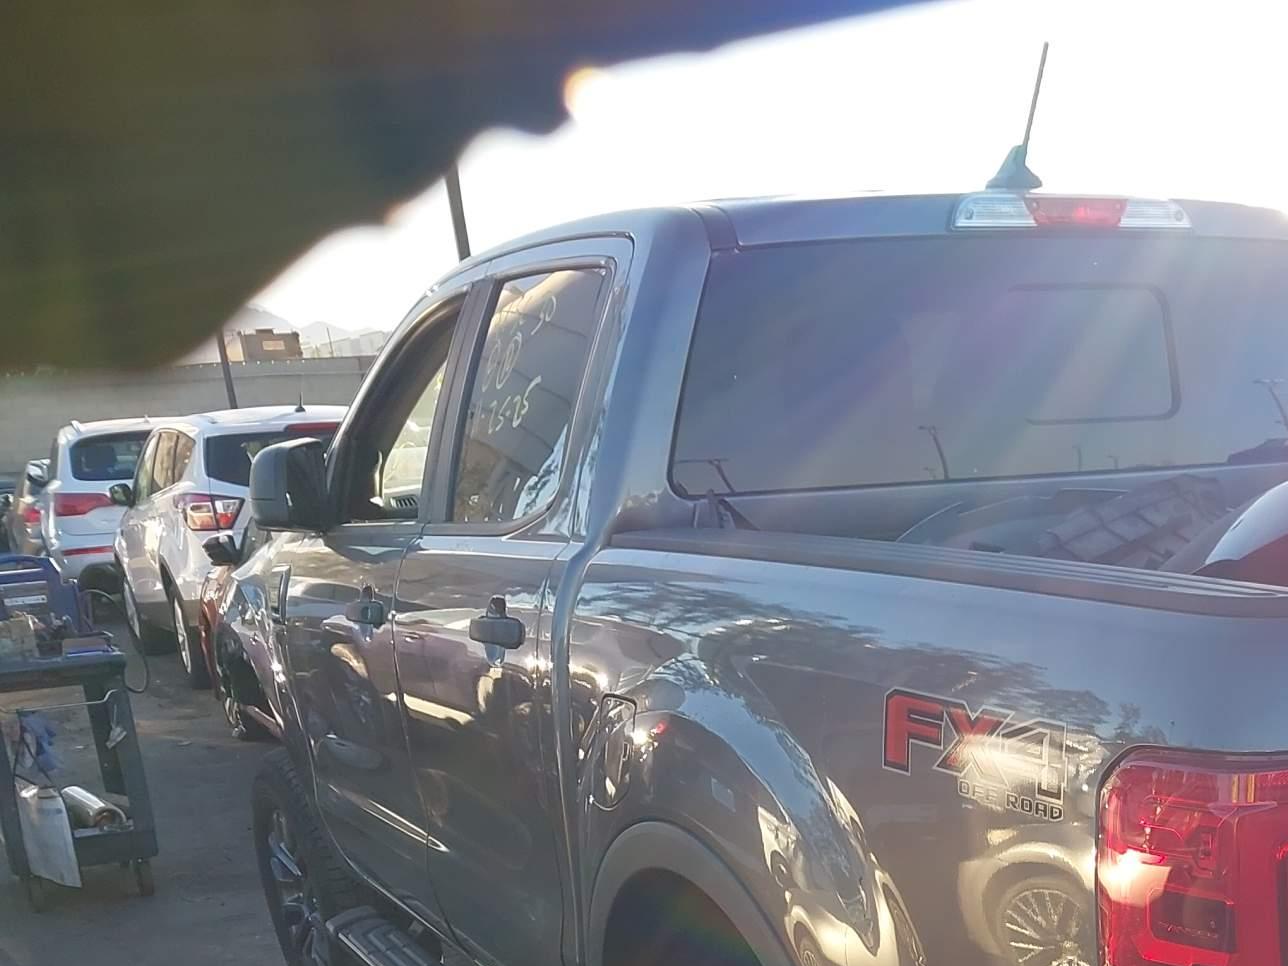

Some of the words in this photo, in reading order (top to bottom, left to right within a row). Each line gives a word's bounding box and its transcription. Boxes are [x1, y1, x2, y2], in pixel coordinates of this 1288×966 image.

[882, 686, 1067, 804] FX4
[958, 779, 1001, 803] OFF
[1005, 791, 1064, 821] ROAD
